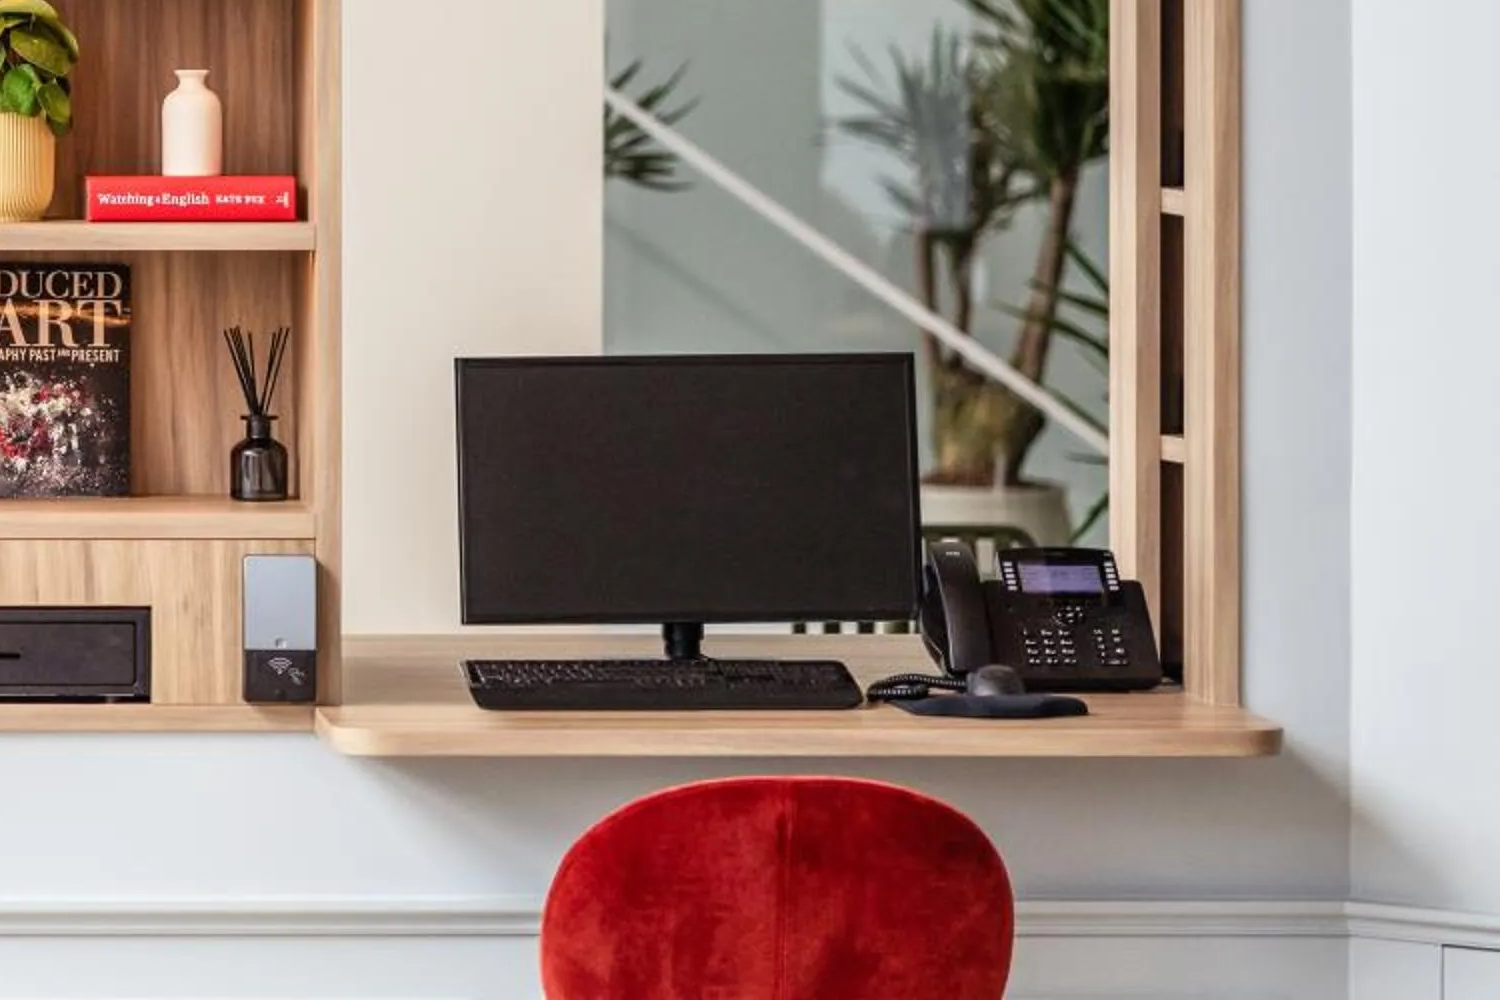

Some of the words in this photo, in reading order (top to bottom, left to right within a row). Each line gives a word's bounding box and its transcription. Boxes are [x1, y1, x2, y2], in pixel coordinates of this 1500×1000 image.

[97, 192, 155, 207] Watching
[161, 192, 210, 207] English
[29, 348, 57, 361] PAST
[71, 350, 120, 362] PRESENT
